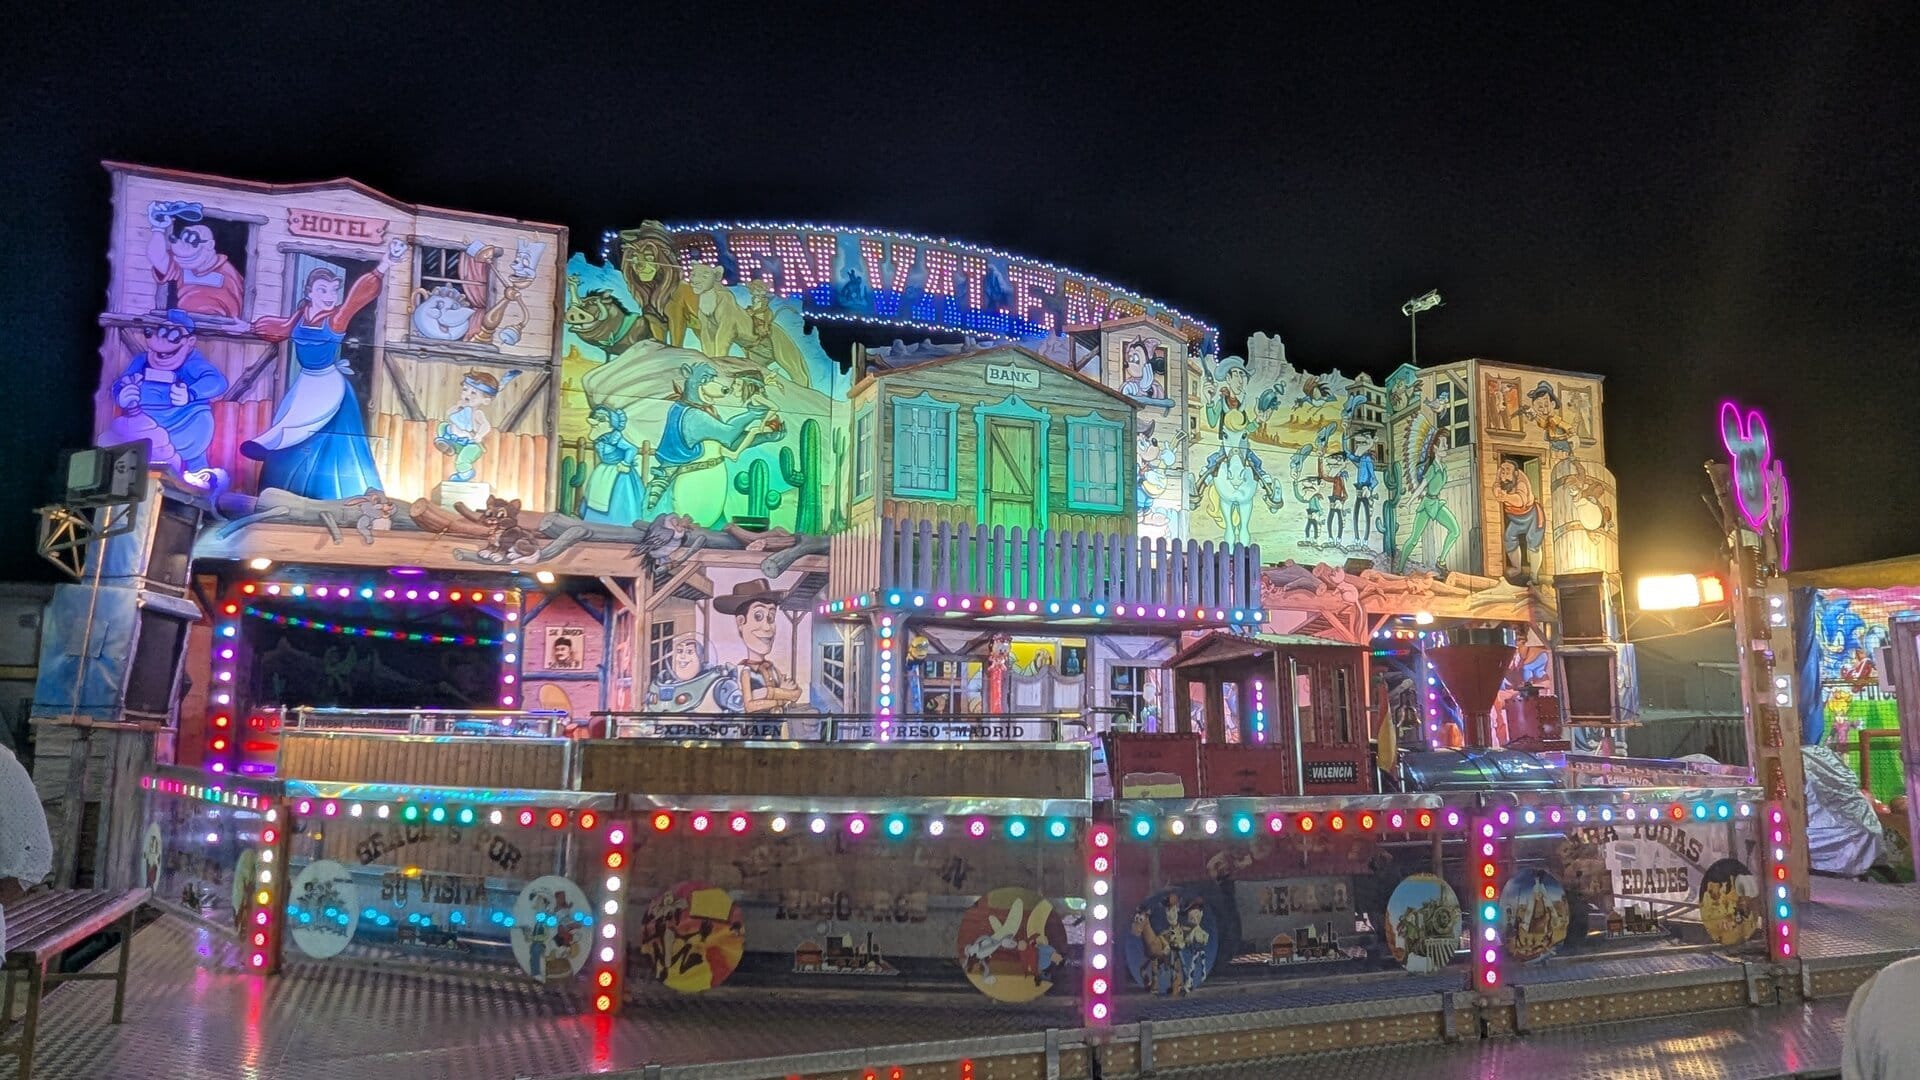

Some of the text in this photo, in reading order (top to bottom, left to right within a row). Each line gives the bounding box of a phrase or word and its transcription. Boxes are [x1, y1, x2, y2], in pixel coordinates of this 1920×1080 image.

[300, 214, 371, 237] HOTEL
[990, 368, 1032, 383] BANK
[654, 724, 729, 736] EXPRESO
[955, 725, 1024, 738] MADRID
[1312, 766, 1353, 779] VALENCIA
[1620, 867, 1689, 895] EDADES
